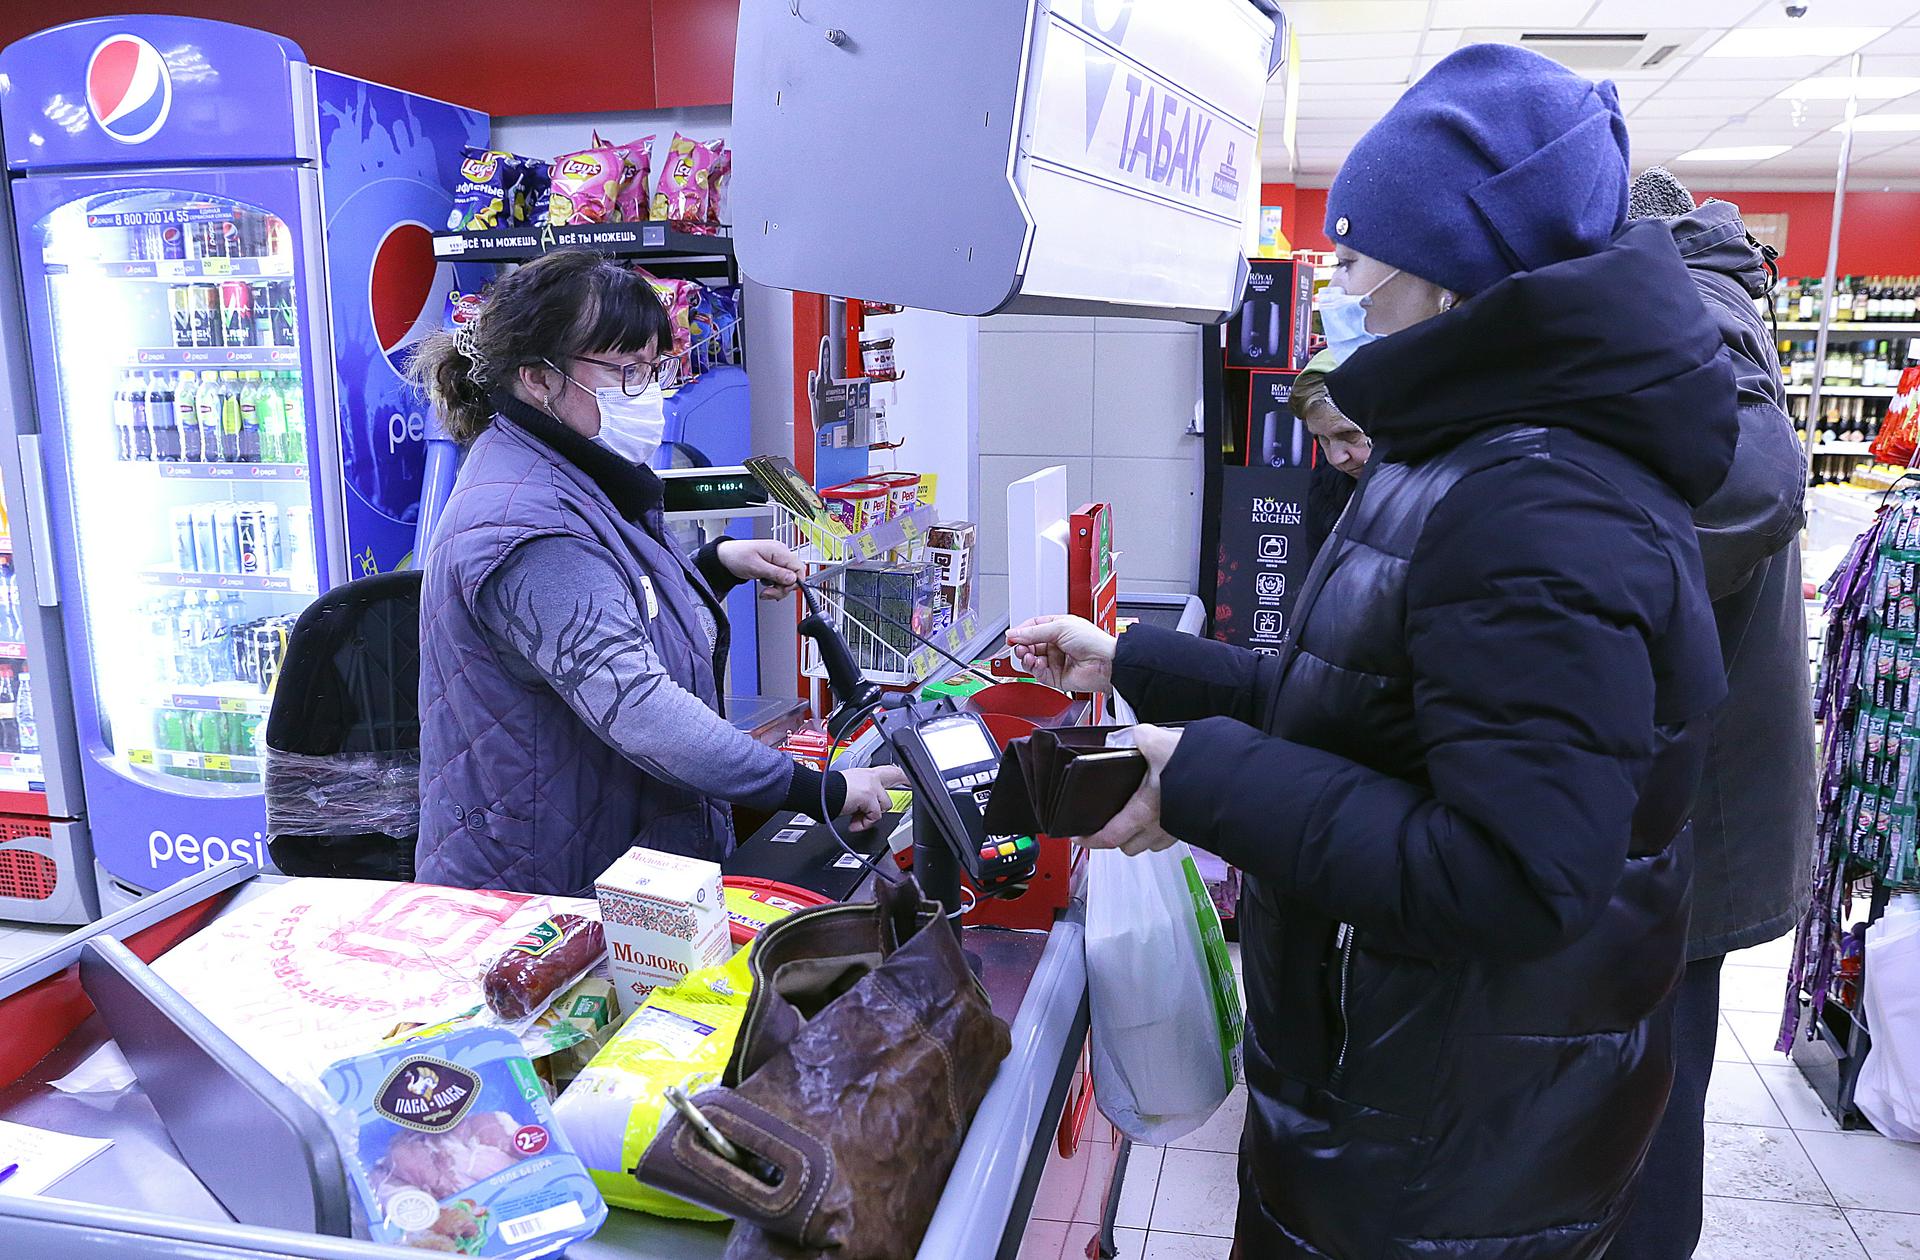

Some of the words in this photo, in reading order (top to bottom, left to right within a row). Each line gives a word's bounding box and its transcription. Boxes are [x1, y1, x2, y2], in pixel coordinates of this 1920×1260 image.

[1118, 73, 1213, 197] ТАБАК
[564, 160, 602, 177] Lay's
[115, 214, 122, 226] 8
[124, 213, 142, 225] 800
[144, 212, 161, 224] 700
[163, 211, 174, 223] 14
[176, 210, 189, 222] 55
[463, 238, 479, 249] ВСЁ
[482, 238, 494, 248] ТЫ
[496, 236, 537, 247] МОЖЕШЬ
[559, 233, 576, 245] ВСЁ
[578, 234, 591, 244] ТЫ
[593, 232, 636, 243] МОЖЕШЬ
[1271, 384, 1292, 392] ROYA
[717, 482, 743, 491] 1469.4
[1252, 498, 1302, 514] ROYAL
[1251, 511, 1301, 525] KÜCHEN
[148, 830, 265, 871] pepsi
[611, 941, 689, 976] Молоко
[518, 1132, 535, 1150] 2
[489, 1169, 519, 1187] ФИЛЕ
[520, 1159, 553, 1178] БЕДРА
